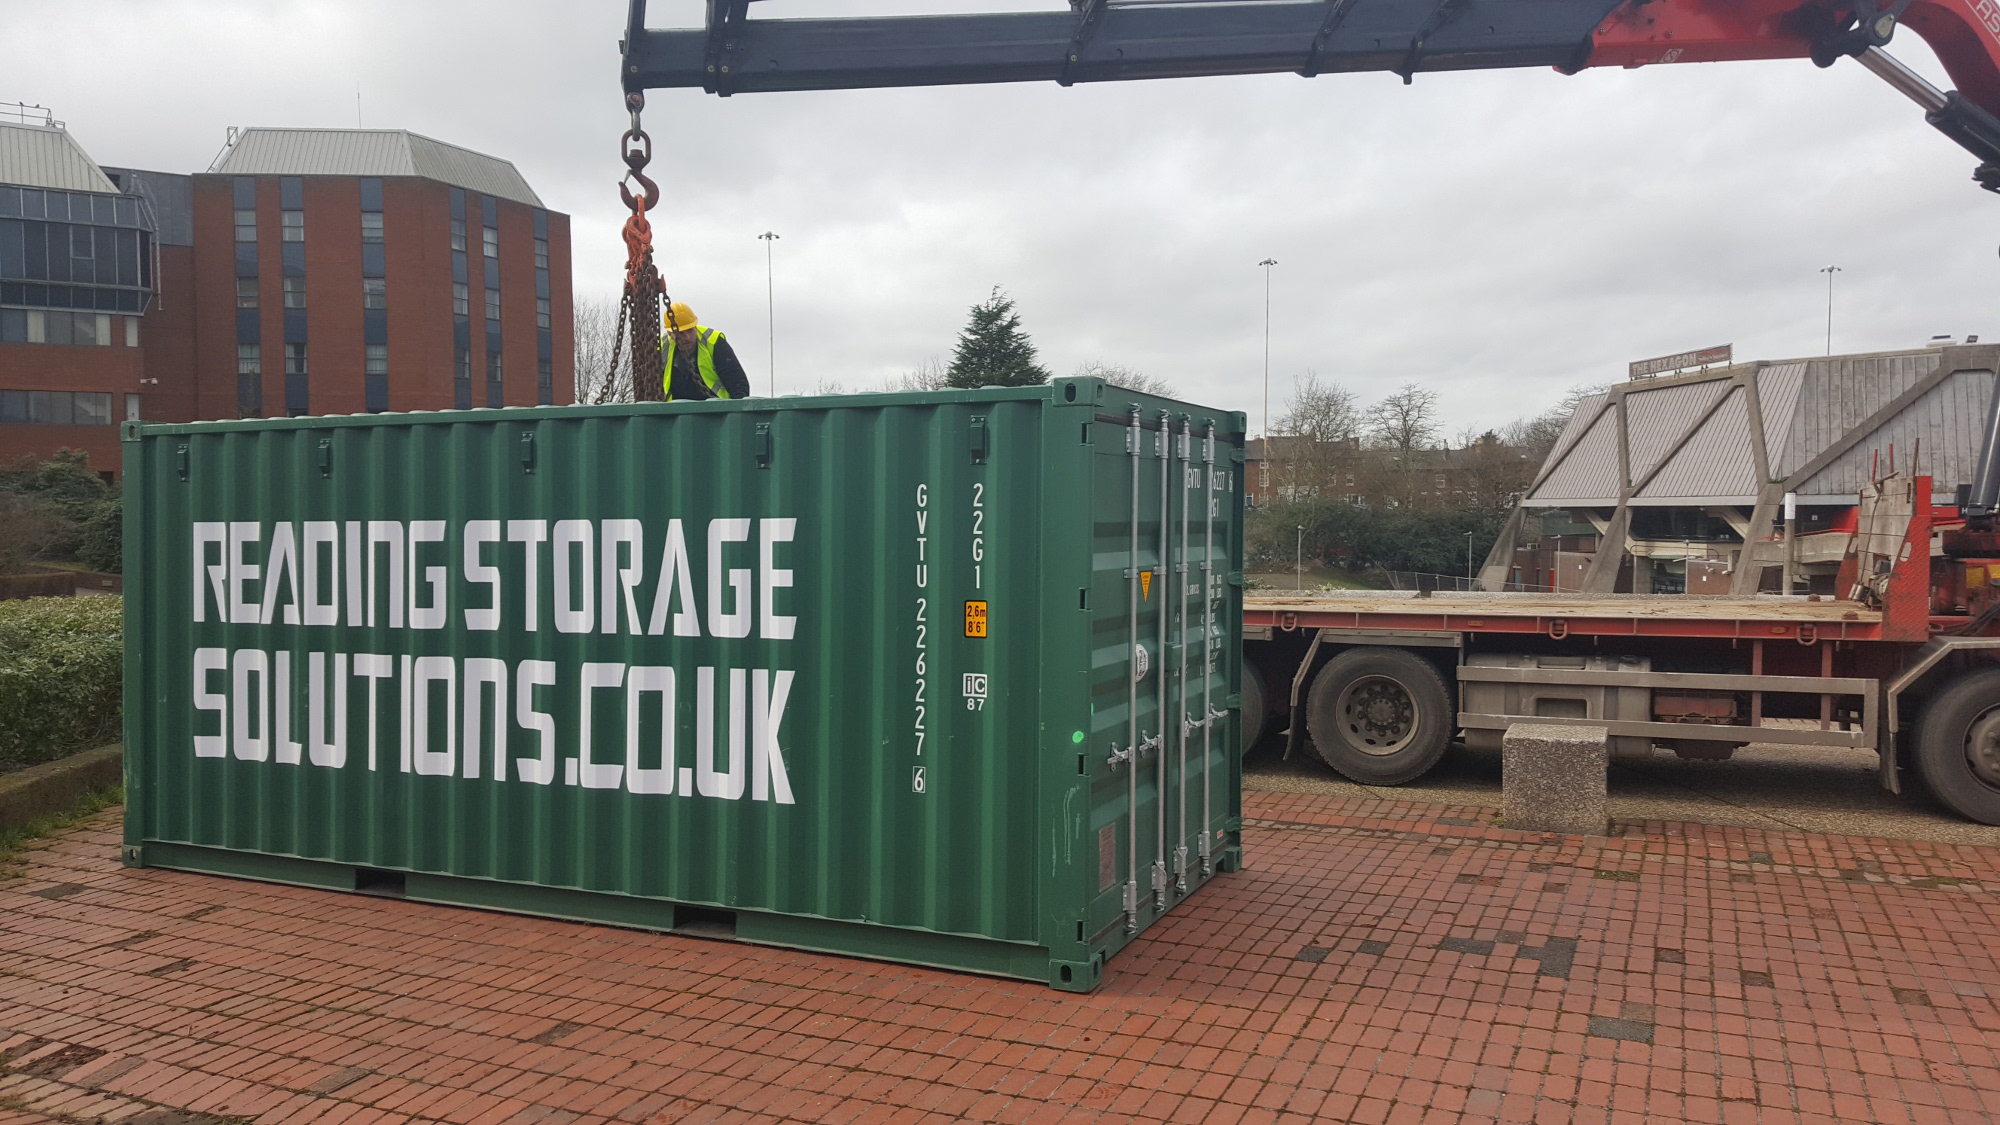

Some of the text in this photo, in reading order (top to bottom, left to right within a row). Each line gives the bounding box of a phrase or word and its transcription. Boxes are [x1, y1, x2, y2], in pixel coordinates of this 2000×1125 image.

[1633, 362, 1649, 375] THE
[1651, 353, 1697, 372] HEXAGON
[1210, 471, 1225, 490] 6227
[193, 518, 797, 640] READING STORAGE
[972, 483, 984, 589] 22G1
[913, 484, 928, 792] GVTU 226227 6
[193, 647, 796, 805] SOLUTIONS.CO.UK
[967, 698, 985, 711] 87
